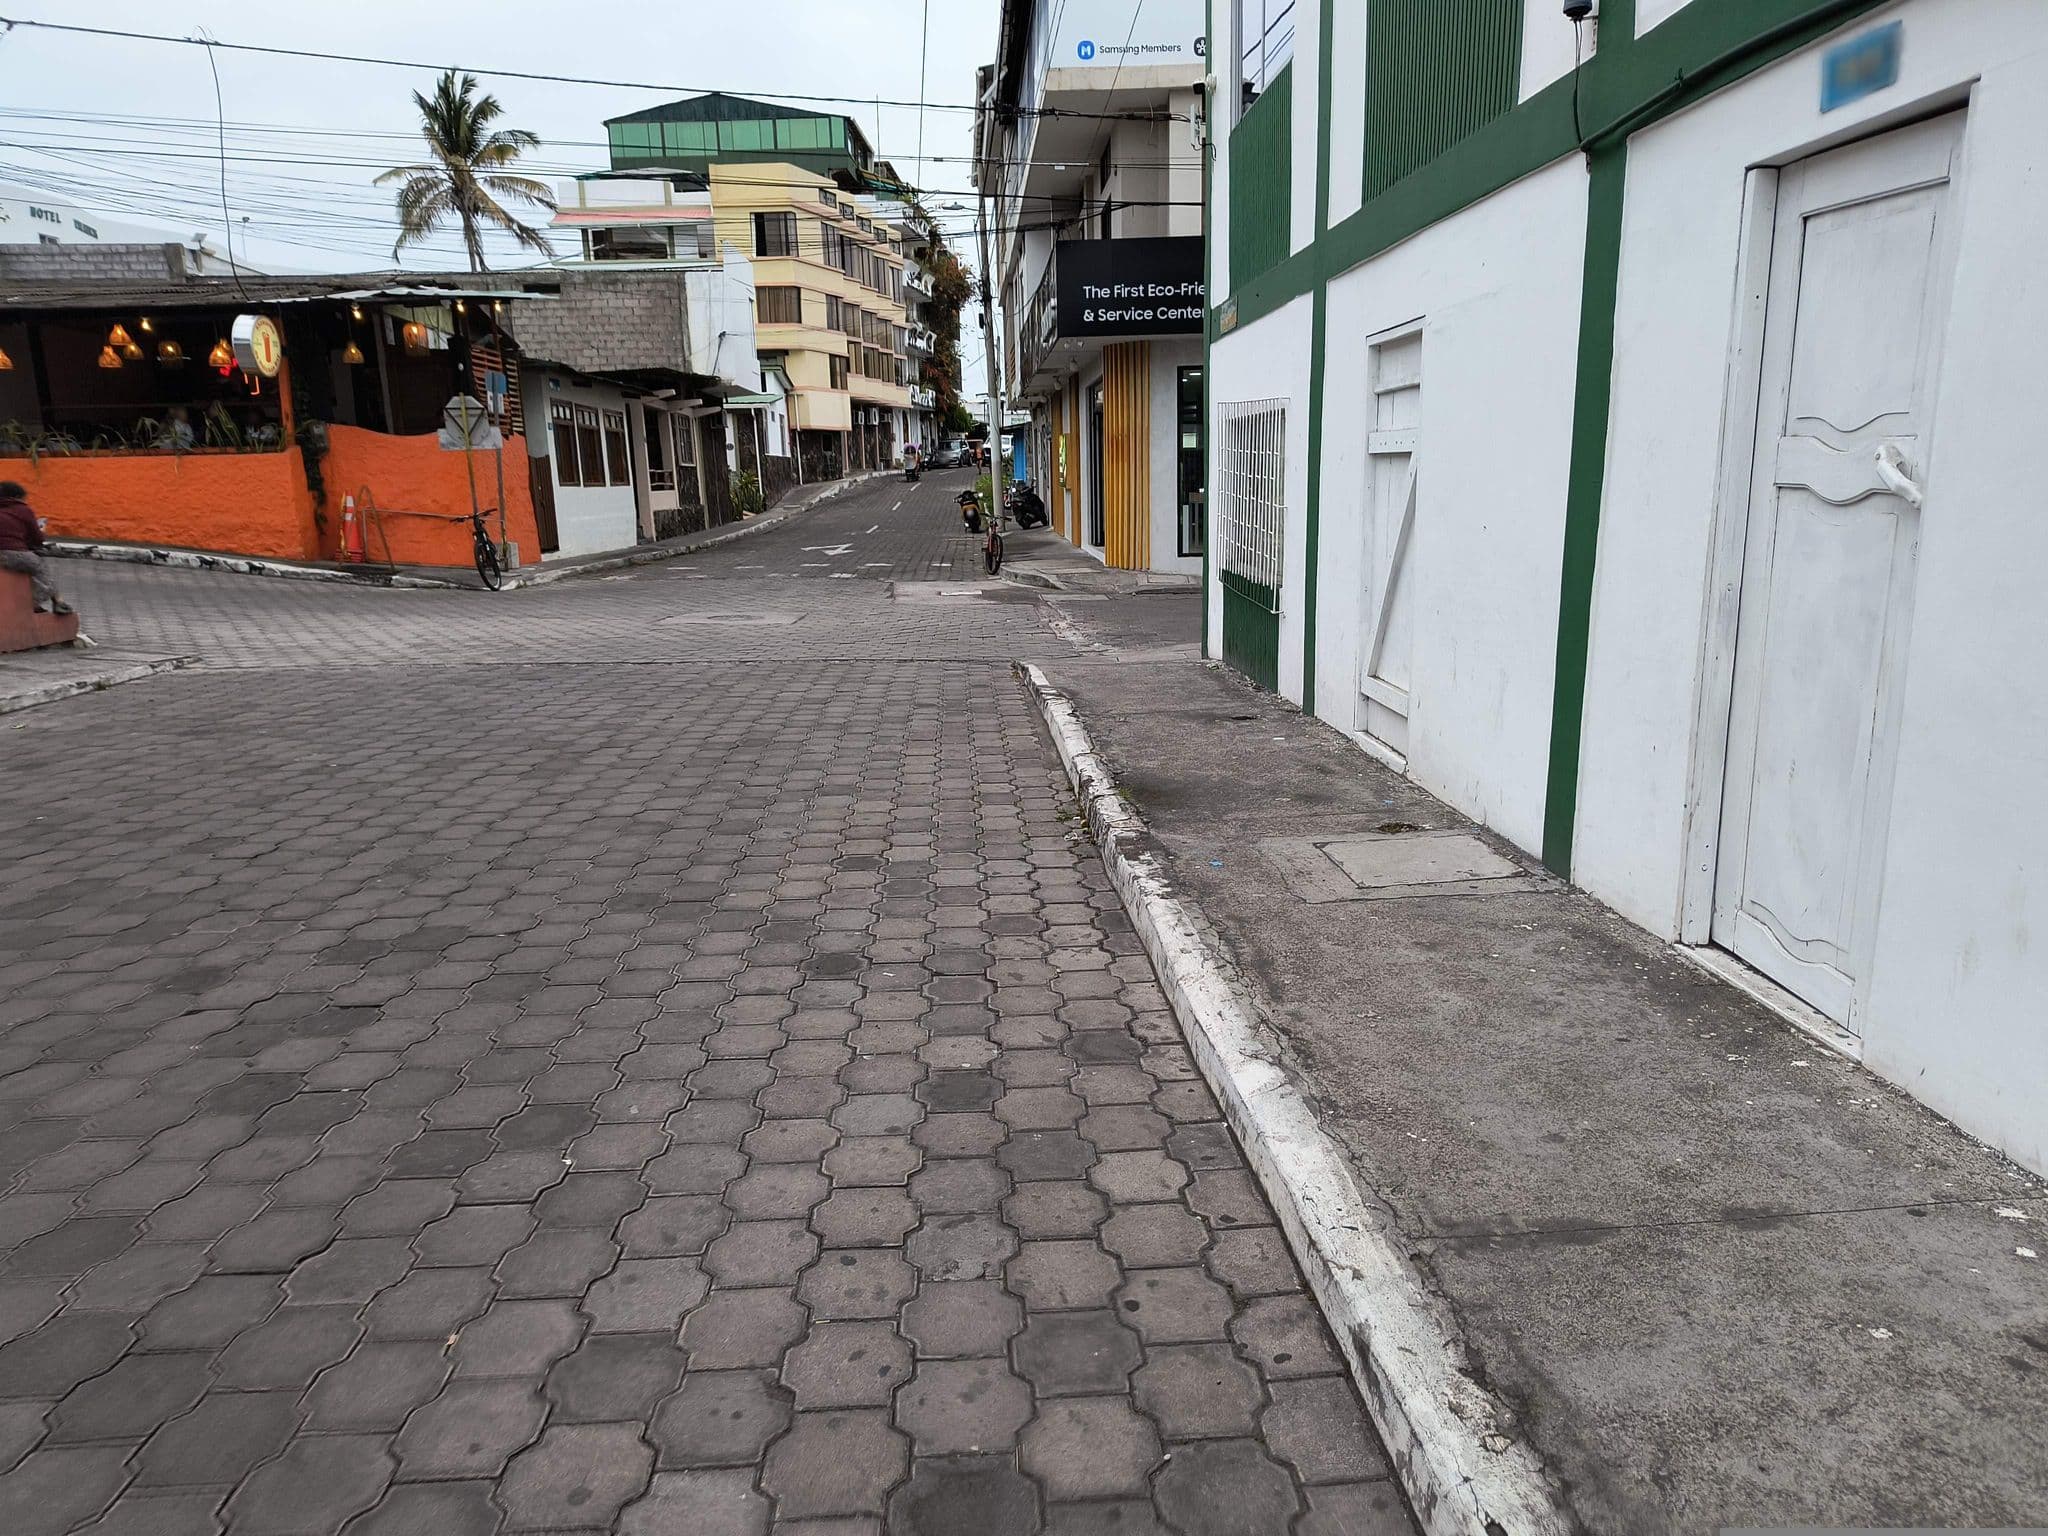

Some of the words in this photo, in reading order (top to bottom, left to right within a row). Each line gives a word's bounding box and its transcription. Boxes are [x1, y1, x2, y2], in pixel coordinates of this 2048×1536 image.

[1099, 44, 1140, 56] Samsung
[1141, 42, 1182, 54] Members
[1083, 285, 1111, 299] The
[1113, 283, 1145, 298] First
[1083, 309, 1095, 322] &
[1098, 306, 1153, 321] Service
